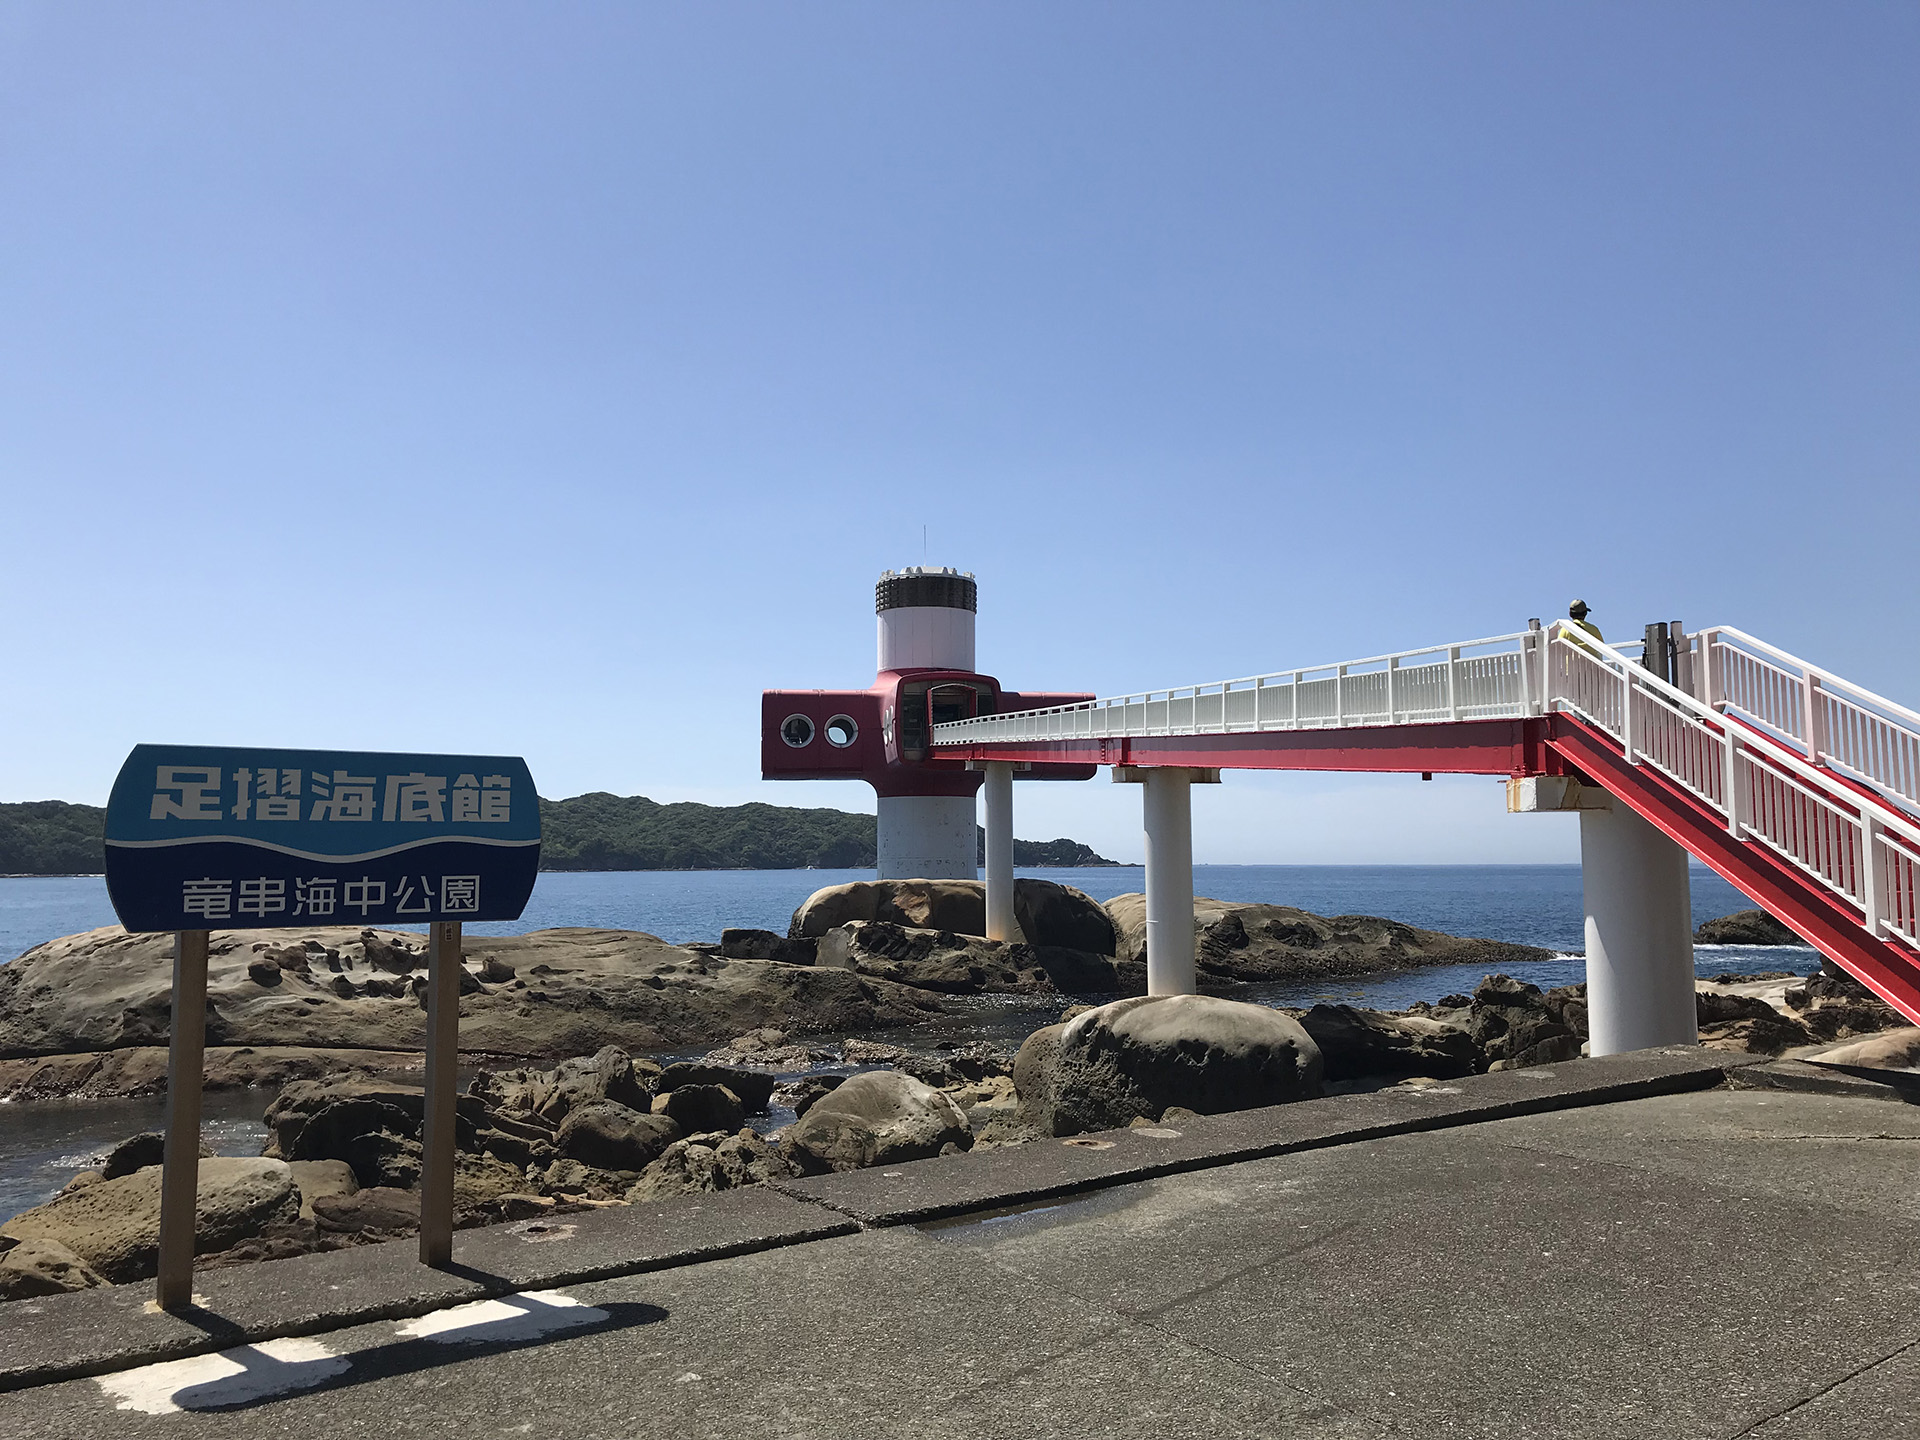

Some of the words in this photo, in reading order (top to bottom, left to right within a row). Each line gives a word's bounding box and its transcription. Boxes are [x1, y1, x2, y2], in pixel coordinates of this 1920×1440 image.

[149, 766, 511, 822] 足摺海底館
[183, 875, 480, 918] 竜串海中公園
